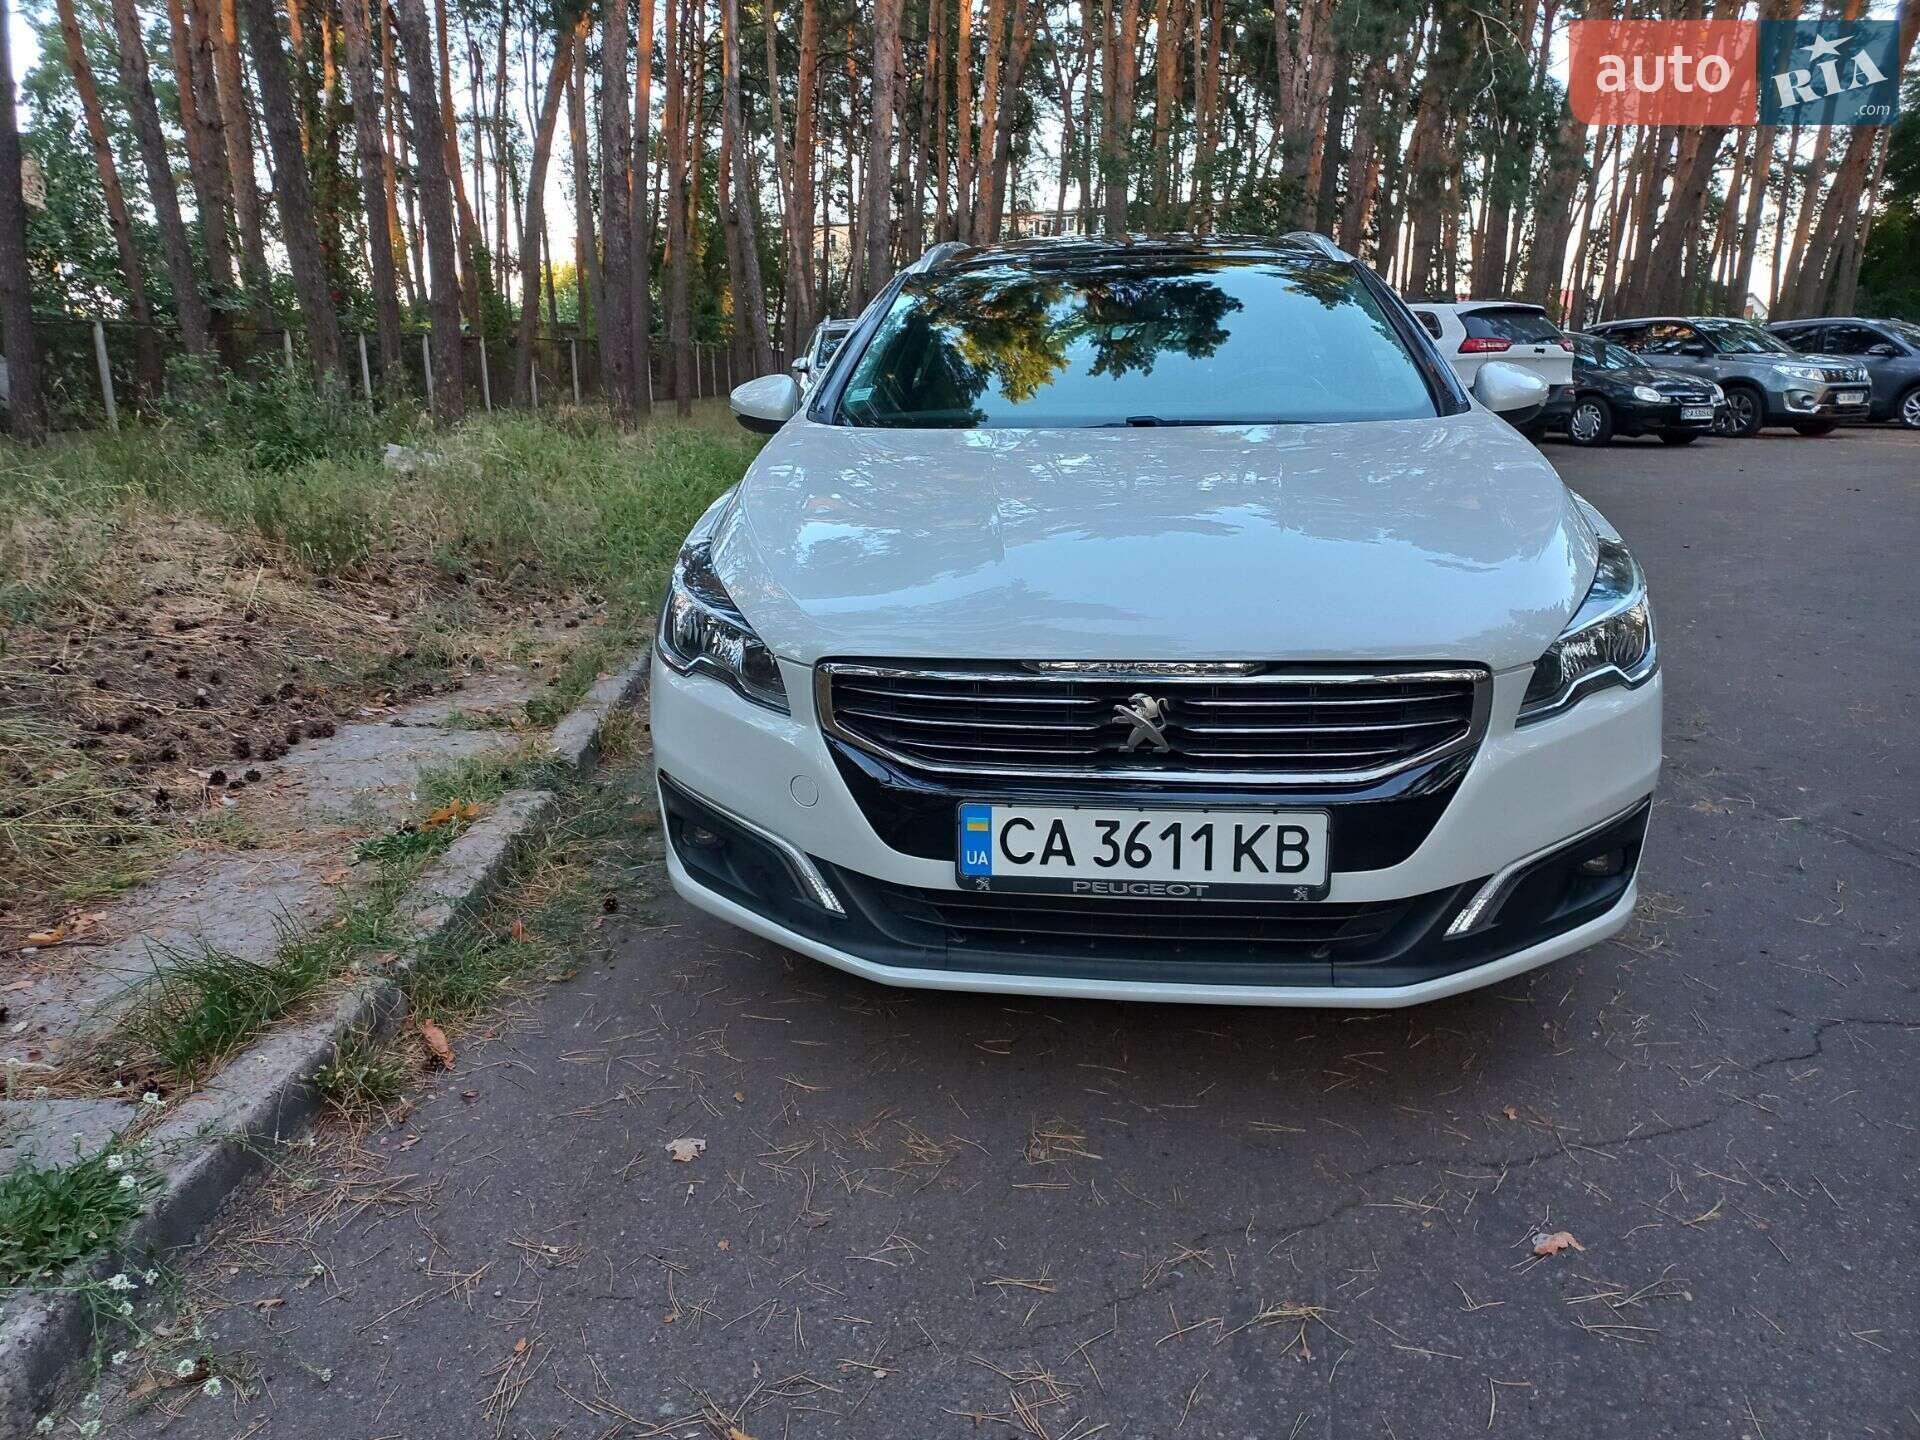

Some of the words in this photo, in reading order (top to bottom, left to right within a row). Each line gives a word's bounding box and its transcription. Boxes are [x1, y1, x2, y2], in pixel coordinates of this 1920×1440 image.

[999, 817, 1076, 867] CA
[1093, 820, 1214, 871] 3611
[1232, 824, 1311, 873] KB
[966, 851, 989, 866] UA
[1072, 881, 1210, 897] PEUGEOT
